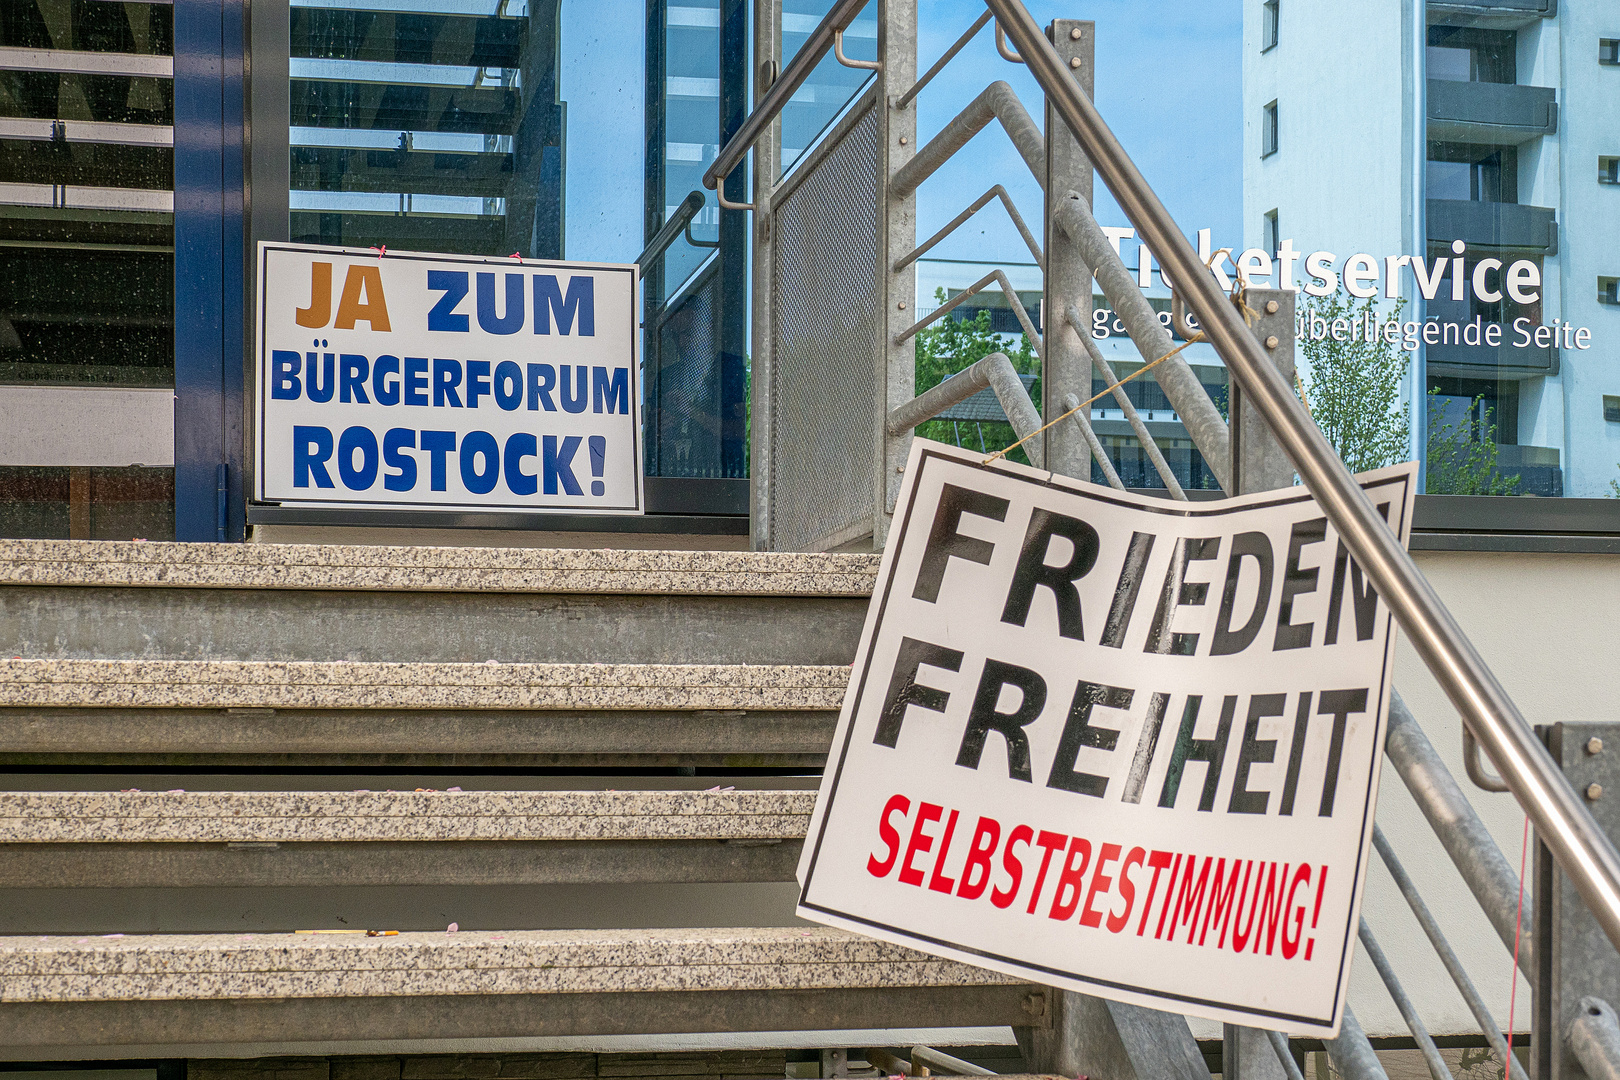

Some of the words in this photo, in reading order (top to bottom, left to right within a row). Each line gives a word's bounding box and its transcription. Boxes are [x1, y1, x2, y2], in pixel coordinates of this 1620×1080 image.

[295, 261, 392, 333] JA
[427, 269, 595, 337] ZUM
[1100, 226, 1541, 305] Tiketservice
[1512, 317, 1592, 350] Seite
[271, 338, 629, 416] BÜRGERFORUM
[293, 425, 607, 497] ROSTOCK!
[911, 482, 1391, 657] FRIEDEN
[872, 635, 1369, 818] FREIHEIT
[866, 793, 1329, 962] SELBSTBESTIMMUNG!
